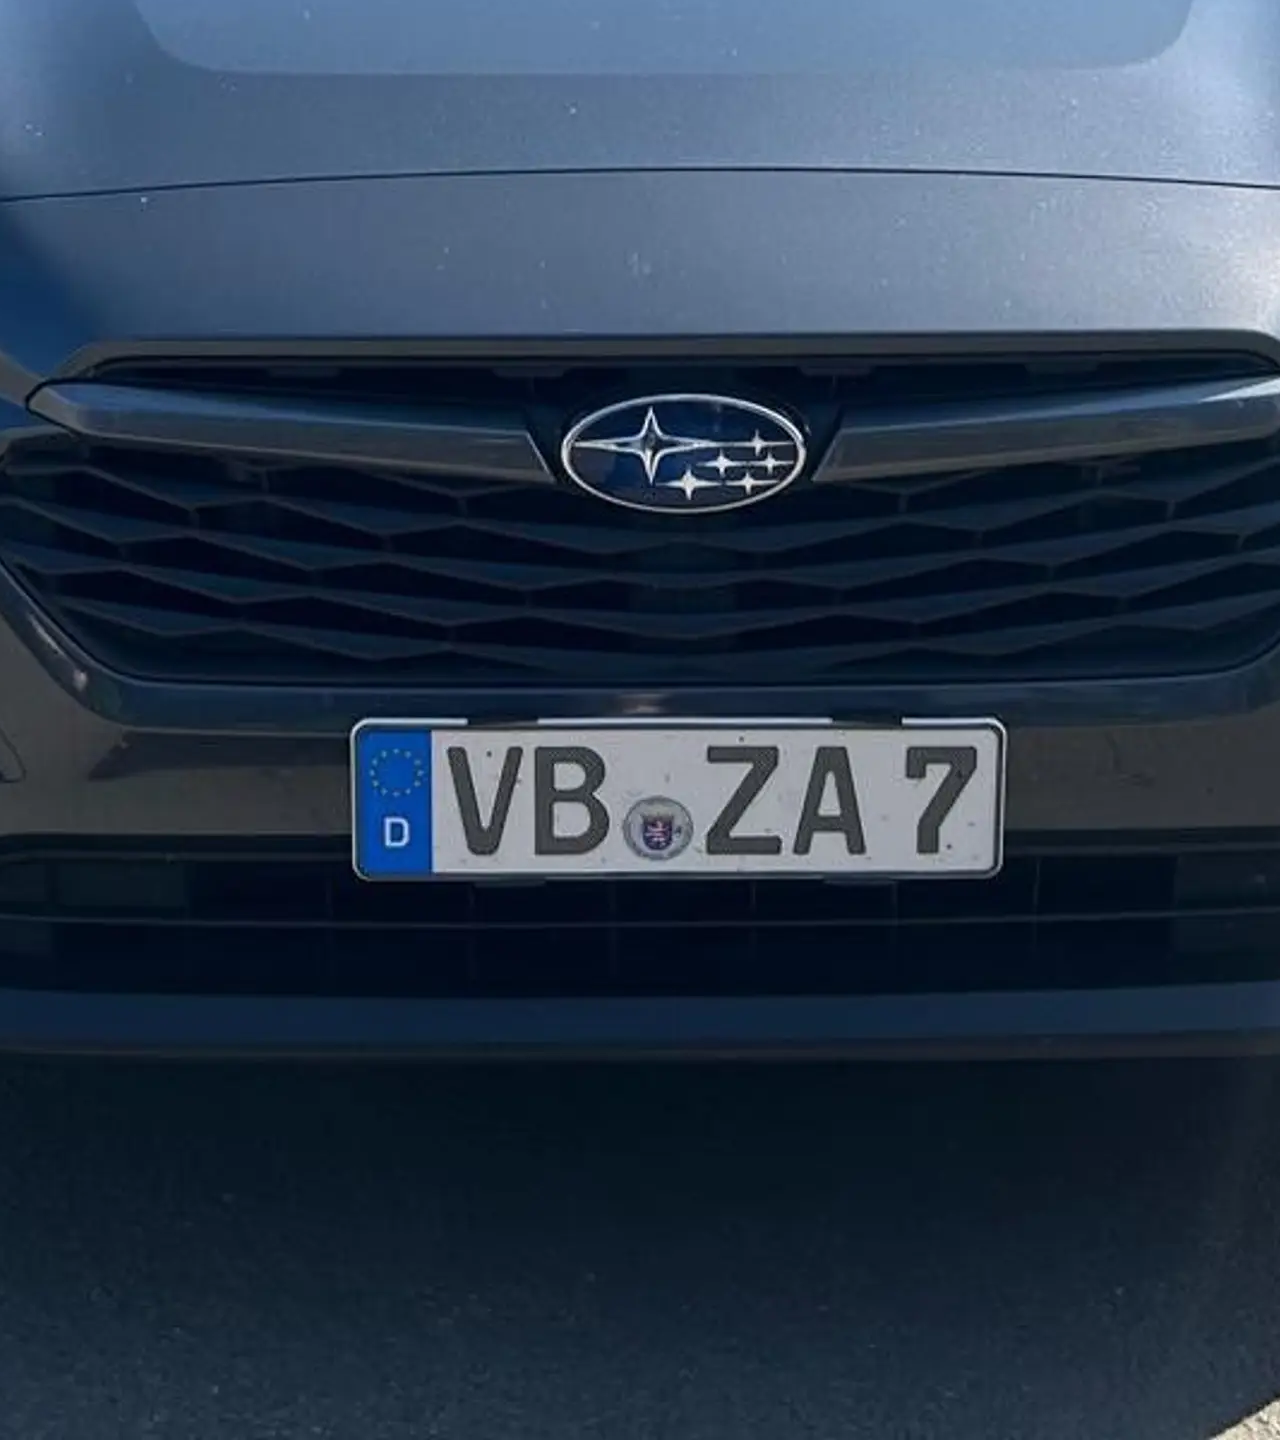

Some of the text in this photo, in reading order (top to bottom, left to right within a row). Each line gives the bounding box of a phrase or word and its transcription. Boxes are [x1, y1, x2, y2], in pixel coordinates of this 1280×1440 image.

[384, 816, 410, 848] D
[446, 745, 979, 856] VB ZA 7
